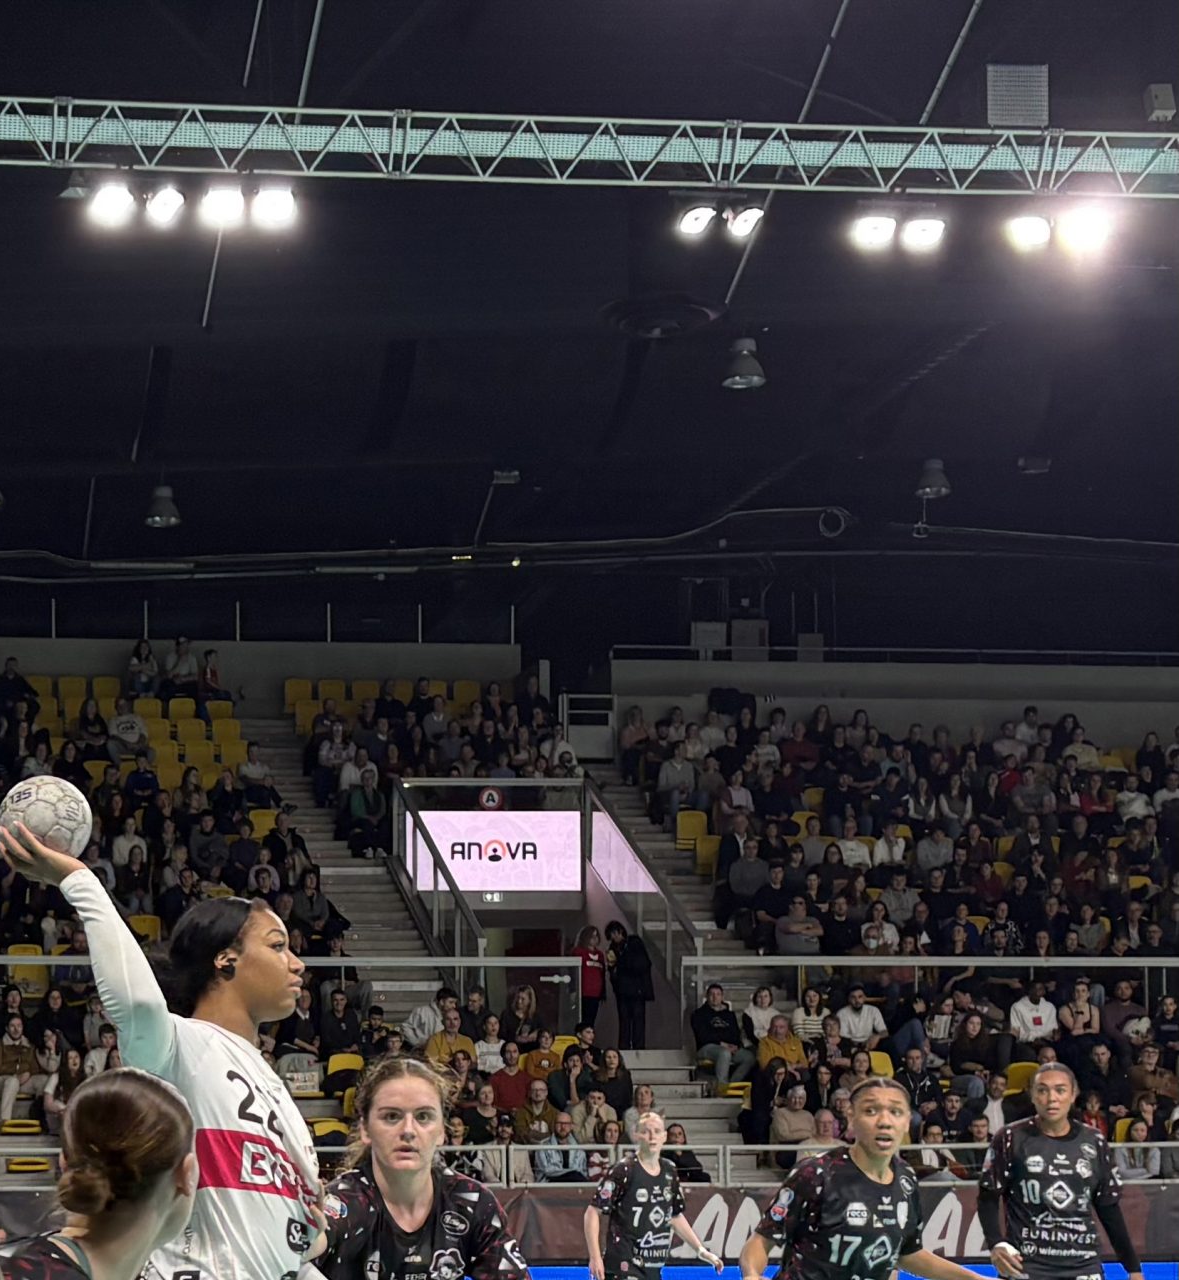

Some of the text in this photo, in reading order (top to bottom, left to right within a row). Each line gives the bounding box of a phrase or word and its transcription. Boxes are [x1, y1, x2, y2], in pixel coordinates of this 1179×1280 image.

[485, 792, 496, 804] A
[450, 840, 538, 862] ANOVA
[1020, 1179, 1041, 1205] 10
[632, 1206, 643, 1228] 7
[828, 1234, 863, 1266] 17
